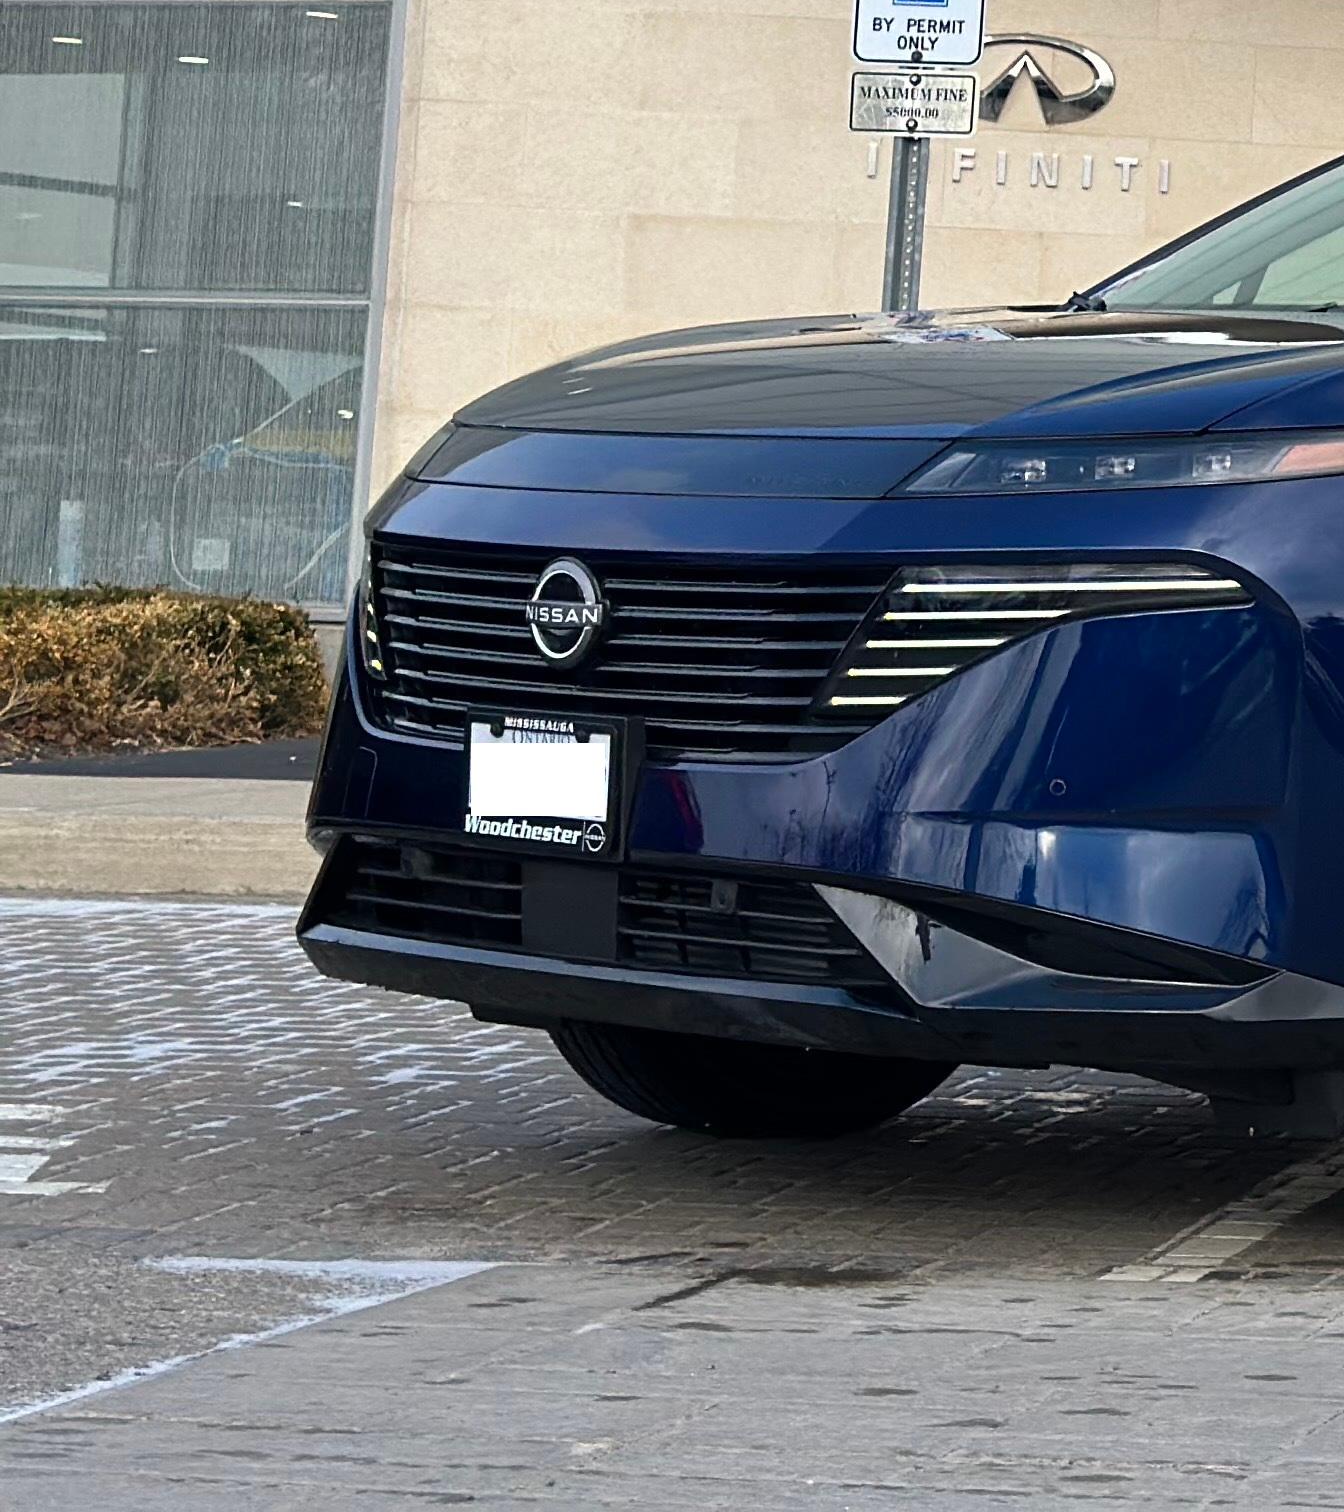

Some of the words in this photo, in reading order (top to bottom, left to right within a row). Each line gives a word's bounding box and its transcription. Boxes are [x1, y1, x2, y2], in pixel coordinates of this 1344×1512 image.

[872, 17, 895, 32] BY
[906, 18, 965, 34] PERMIT
[897, 35, 939, 51] ONLY
[860, 86, 932, 102] MAXIMUM
[935, 88, 968, 102] FINE
[867, 140, 1170, 194] IFINITI
[525, 604, 598, 624] NISSAN
[504, 716, 574, 733] MISSISSAUGA
[464, 813, 582, 845] Woodchester
